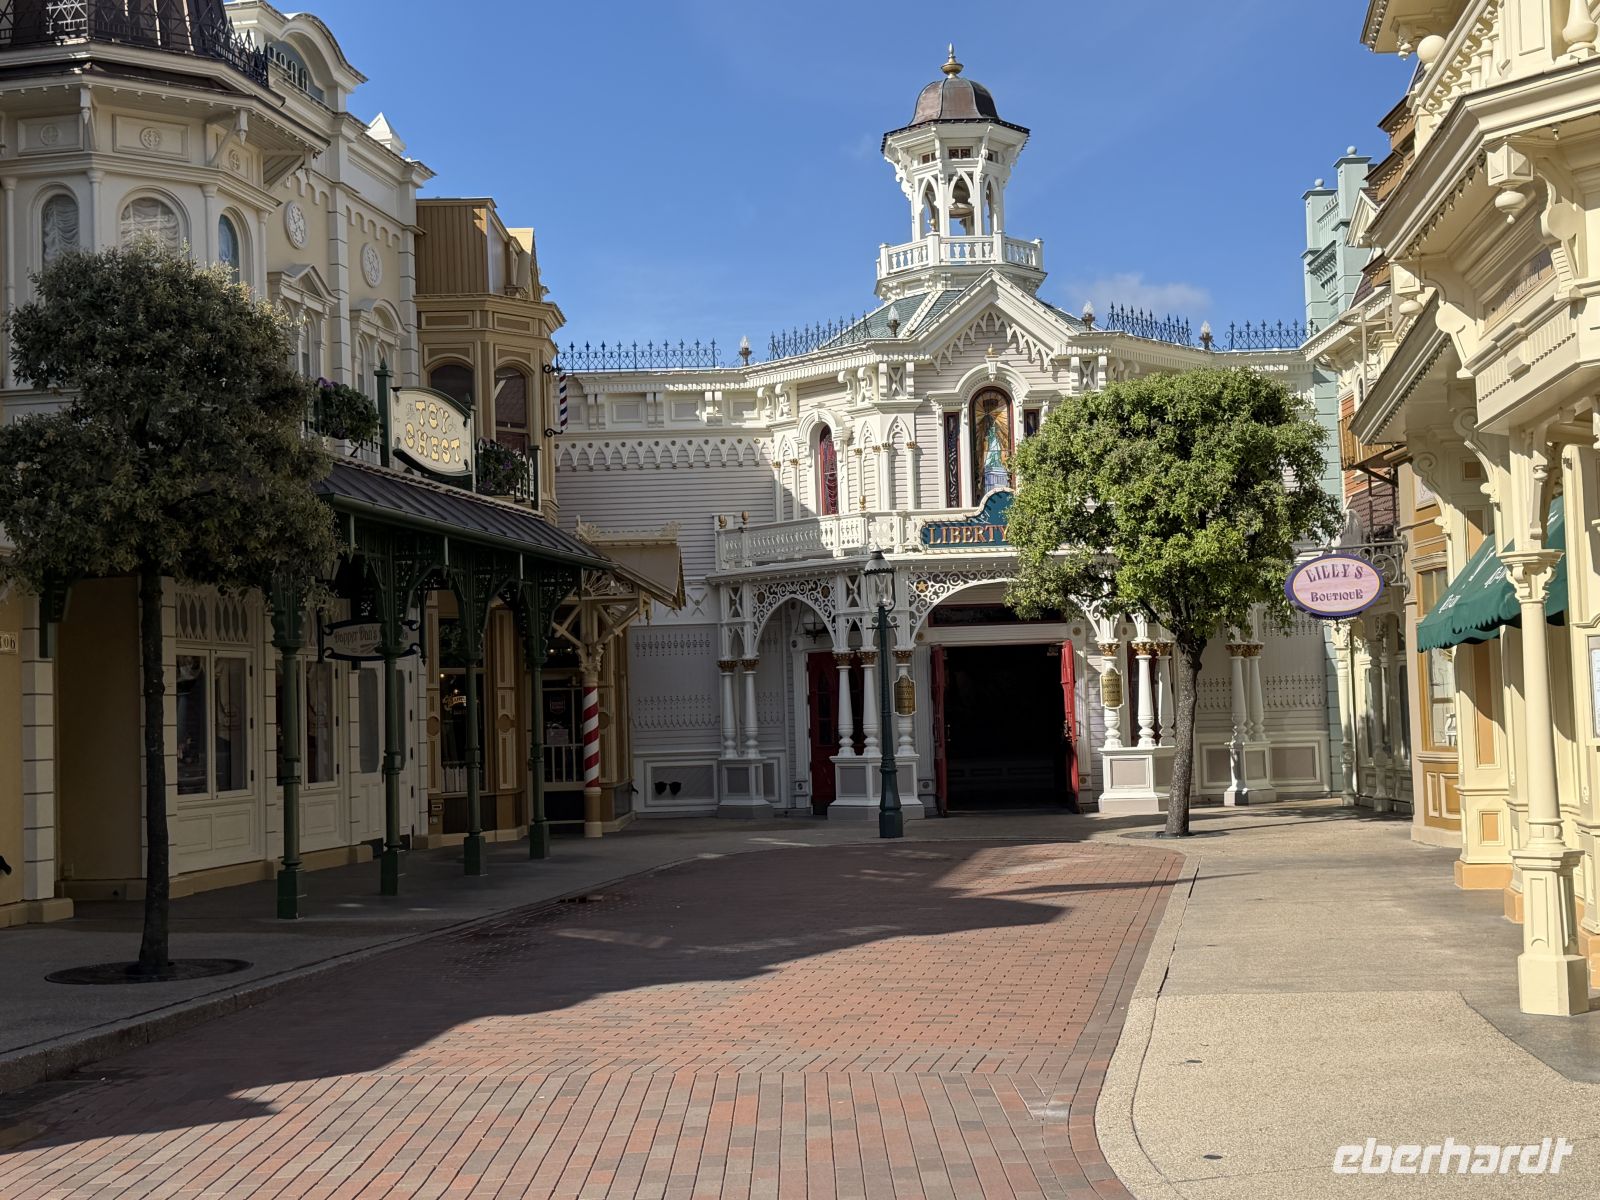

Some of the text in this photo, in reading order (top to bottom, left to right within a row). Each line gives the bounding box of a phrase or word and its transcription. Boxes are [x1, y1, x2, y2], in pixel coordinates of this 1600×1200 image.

[415, 400, 449, 434] TOY
[405, 422, 460, 464] CHEST
[929, 525, 1009, 544] LIBERTY
[1305, 563, 1364, 583] LILLY'S
